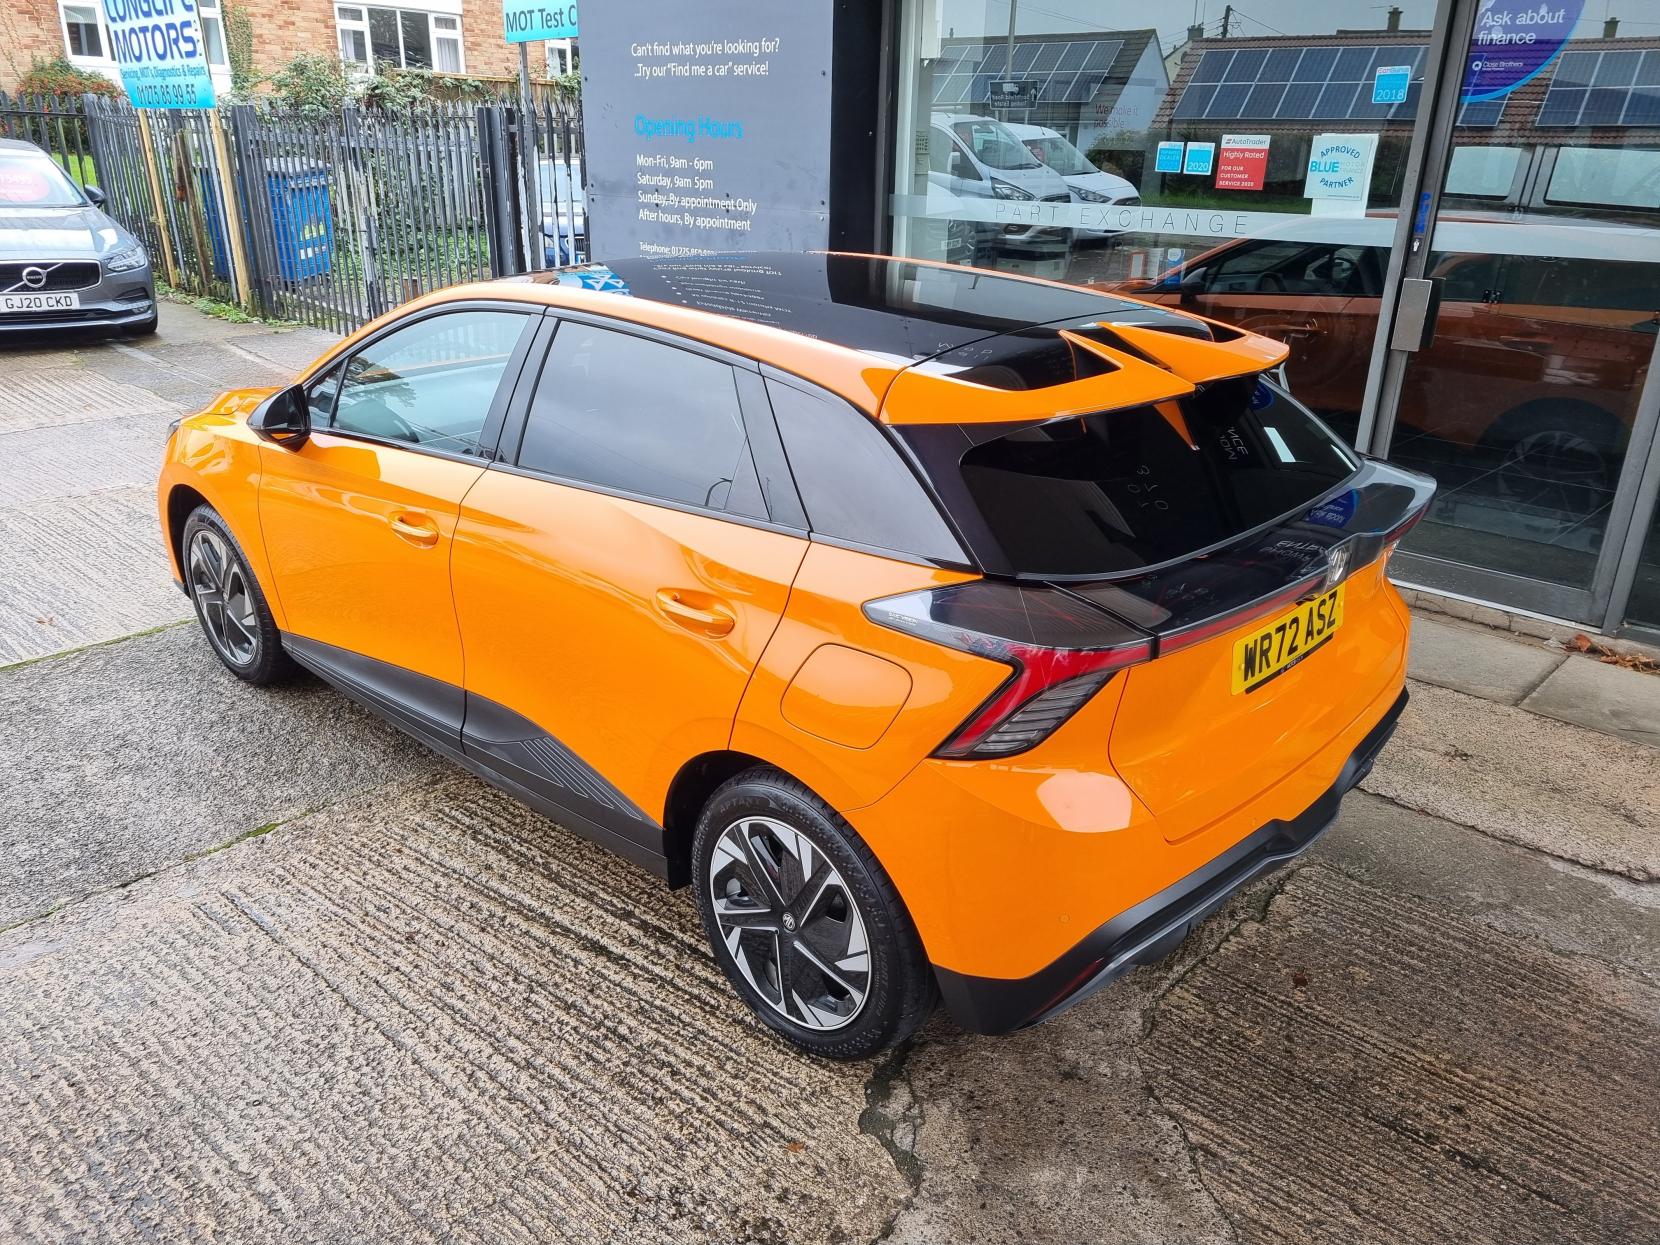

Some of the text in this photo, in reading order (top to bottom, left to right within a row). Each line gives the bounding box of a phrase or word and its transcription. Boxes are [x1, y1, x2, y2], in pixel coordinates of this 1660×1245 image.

[506, 10, 534, 32] MOT
[538, 8, 564, 29] Test
[1480, 9, 1566, 26] Ask about
[114, 20, 198, 64] MOTORS
[1478, 31, 1536, 45] finance
[631, 38, 780, 58] Can't find what you're looking for?
[153, 66, 181, 80] Diagnostics
[187, 65, 206, 78] Repairs
[652, 66, 666, 77] our
[692, 65, 705, 76] me
[708, 66, 712, 76] a
[715, 62, 732, 76] car"
[734, 61, 769, 76] service!
[136, 84, 197, 105] 01275 85 99 55
[1376, 90, 1405, 100] 2018
[1095, 104, 1108, 115] We
[634, 113, 744, 143] Opening Hours
[1223, 151, 1243, 159] Highly
[1320, 145, 1360, 159] APPROVED
[636, 154, 668, 168] Mon-Fri,
[670, 156, 688, 168] 9am
[694, 157, 713, 172] 6pm
[1188, 162, 1209, 171] 2020
[1310, 160, 1339, 173] BLUE
[637, 172, 713, 191] Saturday, 9am 5pm
[1320, 176, 1354, 188] PARTNER
[638, 190, 757, 215] Sunday, By appointment Only
[639, 209, 750, 231] After hours, By appointment
[995, 204, 1248, 235] PART EXCHANGE
[5, 295, 73, 309] GJ20 CKD
[1244, 590, 1337, 682] WR72 ASZ
